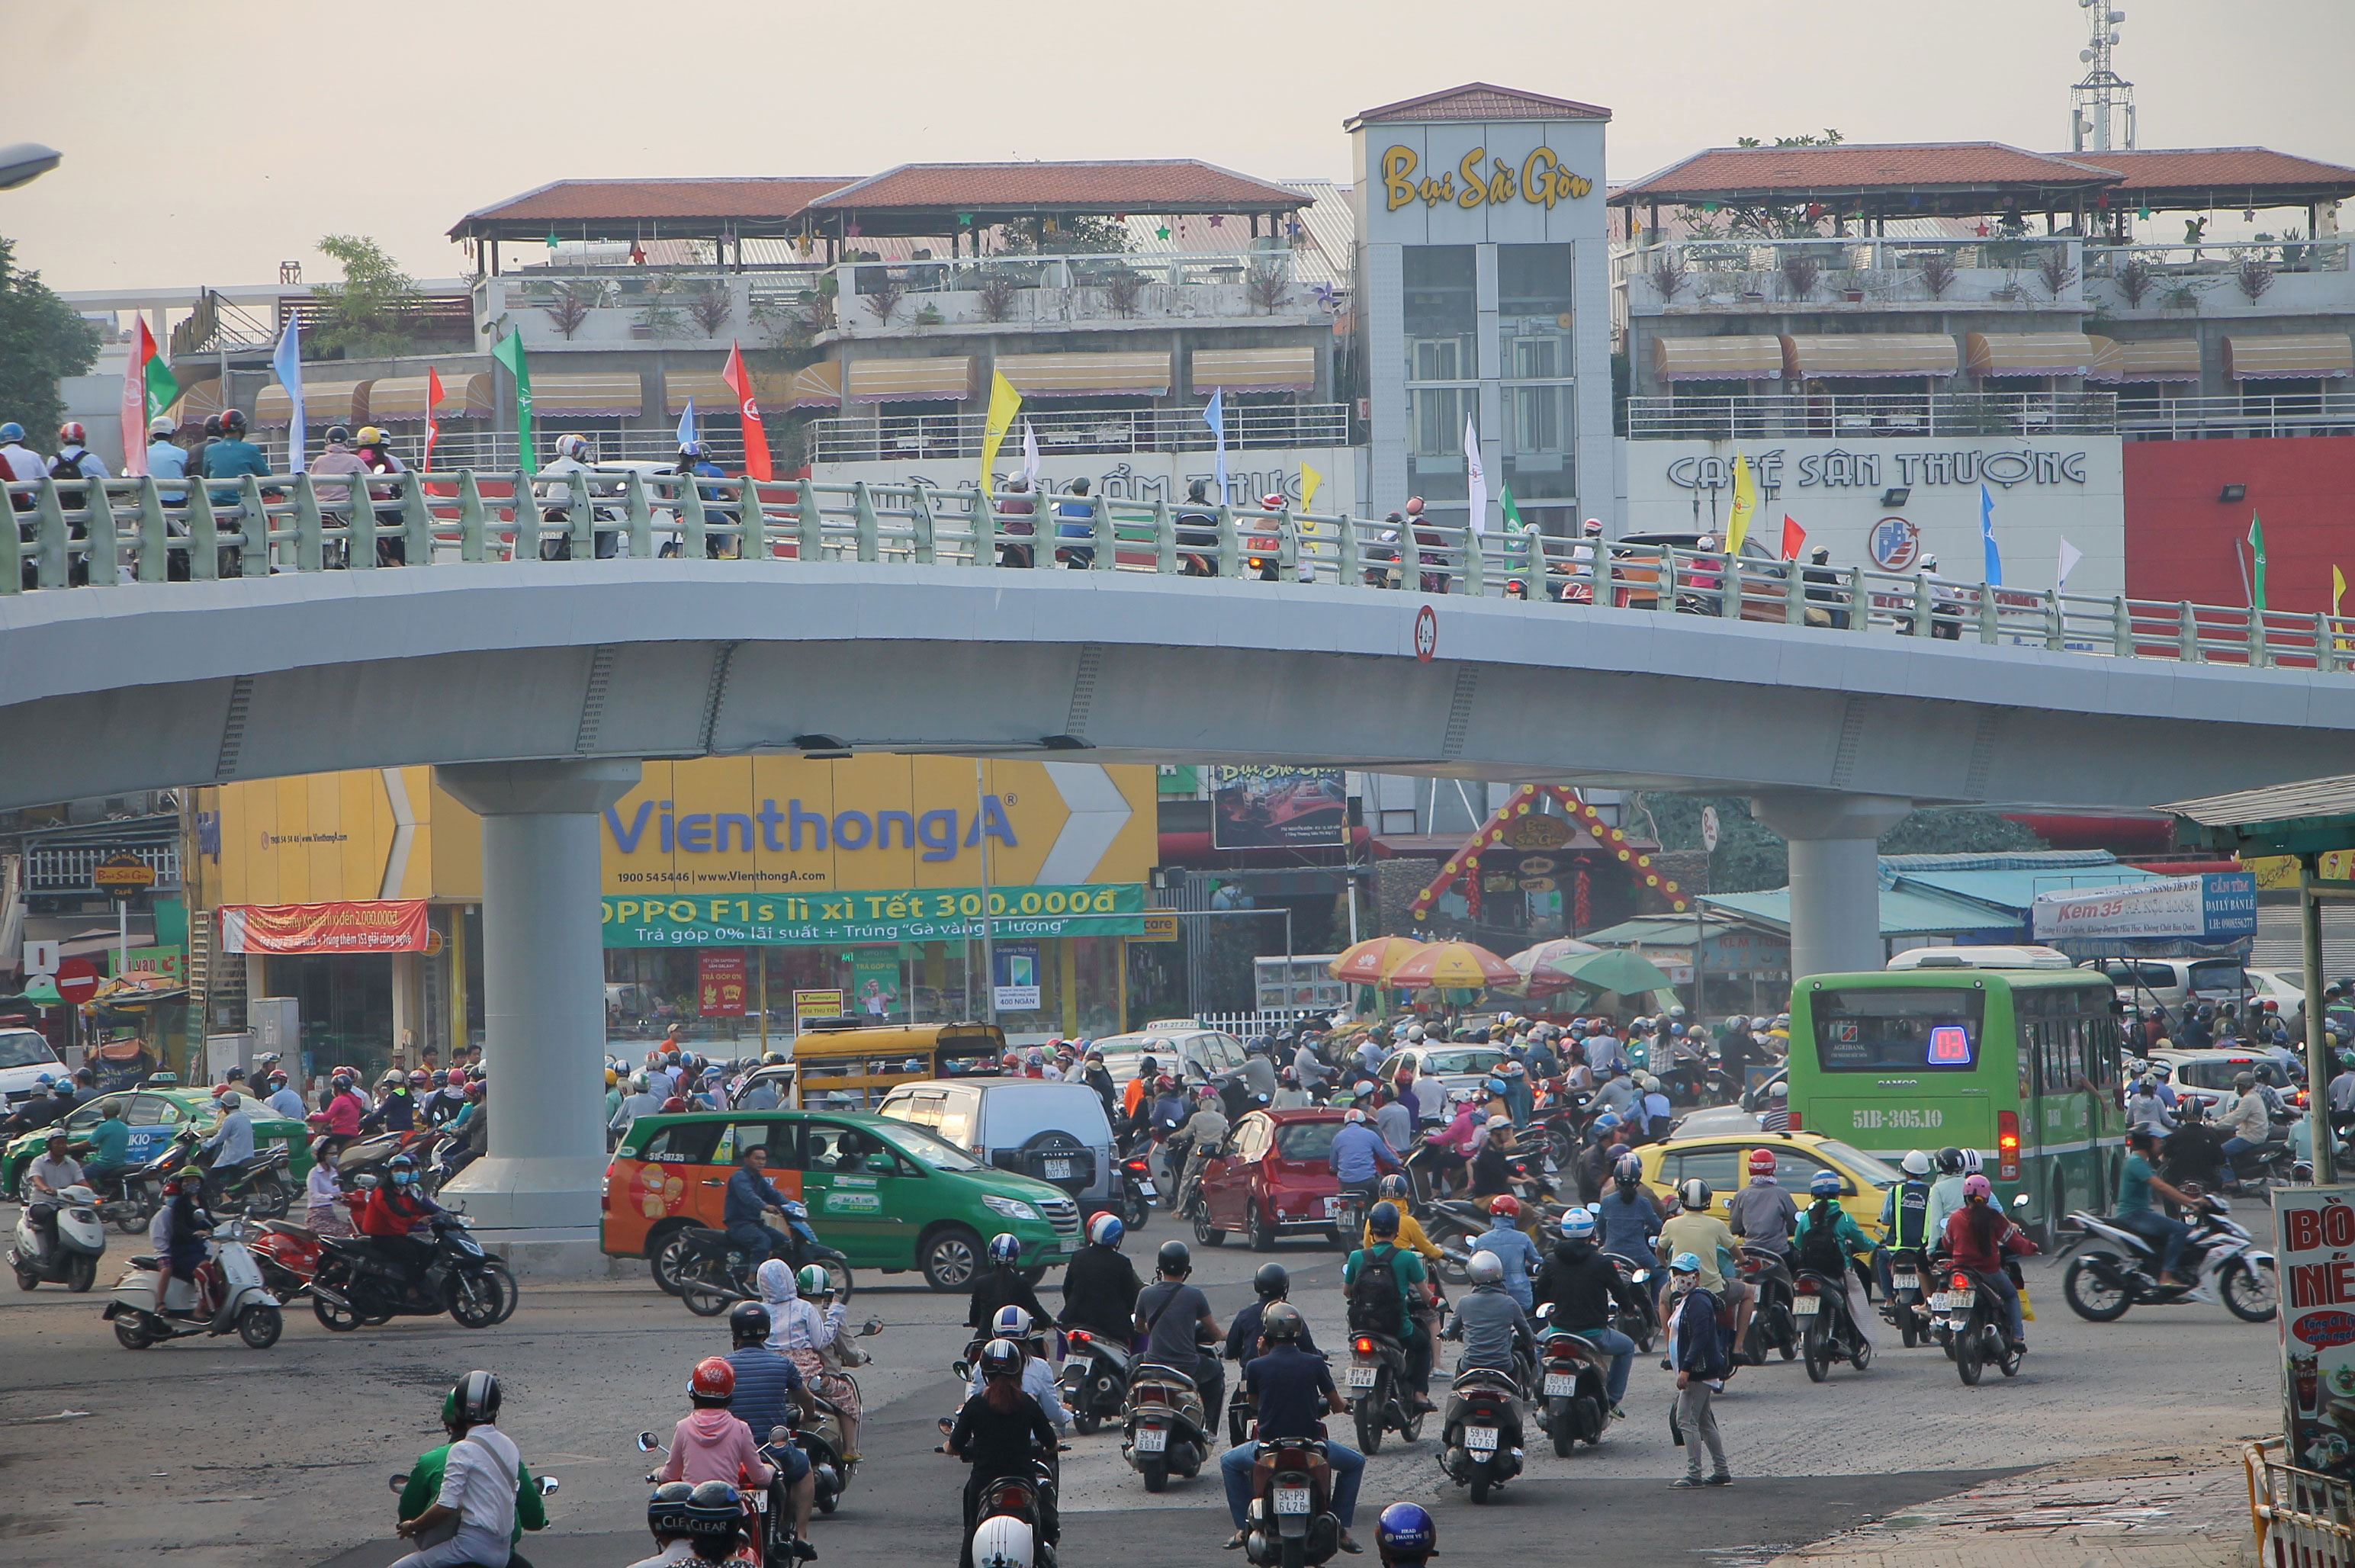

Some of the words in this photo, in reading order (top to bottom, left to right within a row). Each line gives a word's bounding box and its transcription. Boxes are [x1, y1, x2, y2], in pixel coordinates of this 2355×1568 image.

[1382, 144, 1454, 210] Bụi
[1458, 146, 1517, 208] Sài
[1521, 146, 1592, 210] Gòn
[1799, 448, 1881, 487] SÂN
[1896, 450, 2086, 488] THƯỢNG
[602, 794, 1018, 863] VienthongA
[618, 872, 643, 882] 1900
[698, 870, 825, 883] www.VienthongA.com
[710, 899, 775, 923] F1s
[788, 897, 808, 921] lì
[821, 893, 853, 920] xì
[865, 892, 923, 920] Tết
[936, 888, 1117, 917] 300.000đ
[2057, 903, 2099, 923] Kem
[2100, 900, 2123, 917] 35
[635, 927, 664, 942] Trả
[671, 927, 708, 944] góp
[715, 927, 744, 940] 0%
[751, 926, 773, 940] lãi
[779, 924, 819, 940] suất
[843, 923, 898, 939] Trúng
[114, 956, 131, 973] Li
[1936, 1030, 1964, 1058] 03
[1852, 1110, 1942, 1129] 51B-305.10
[2283, 1196, 2355, 1252] BÒ
[1470, 1428, 1492, 1438] 59-V2
[1139, 1440, 1161, 1450] 6618
[1467, 1438, 1496, 1448] 447.62
[1277, 1489, 1307, 1501] 54-P9
[1277, 1501, 1308, 1512] 6426
[690, 1519, 727, 1531] CLEAR
